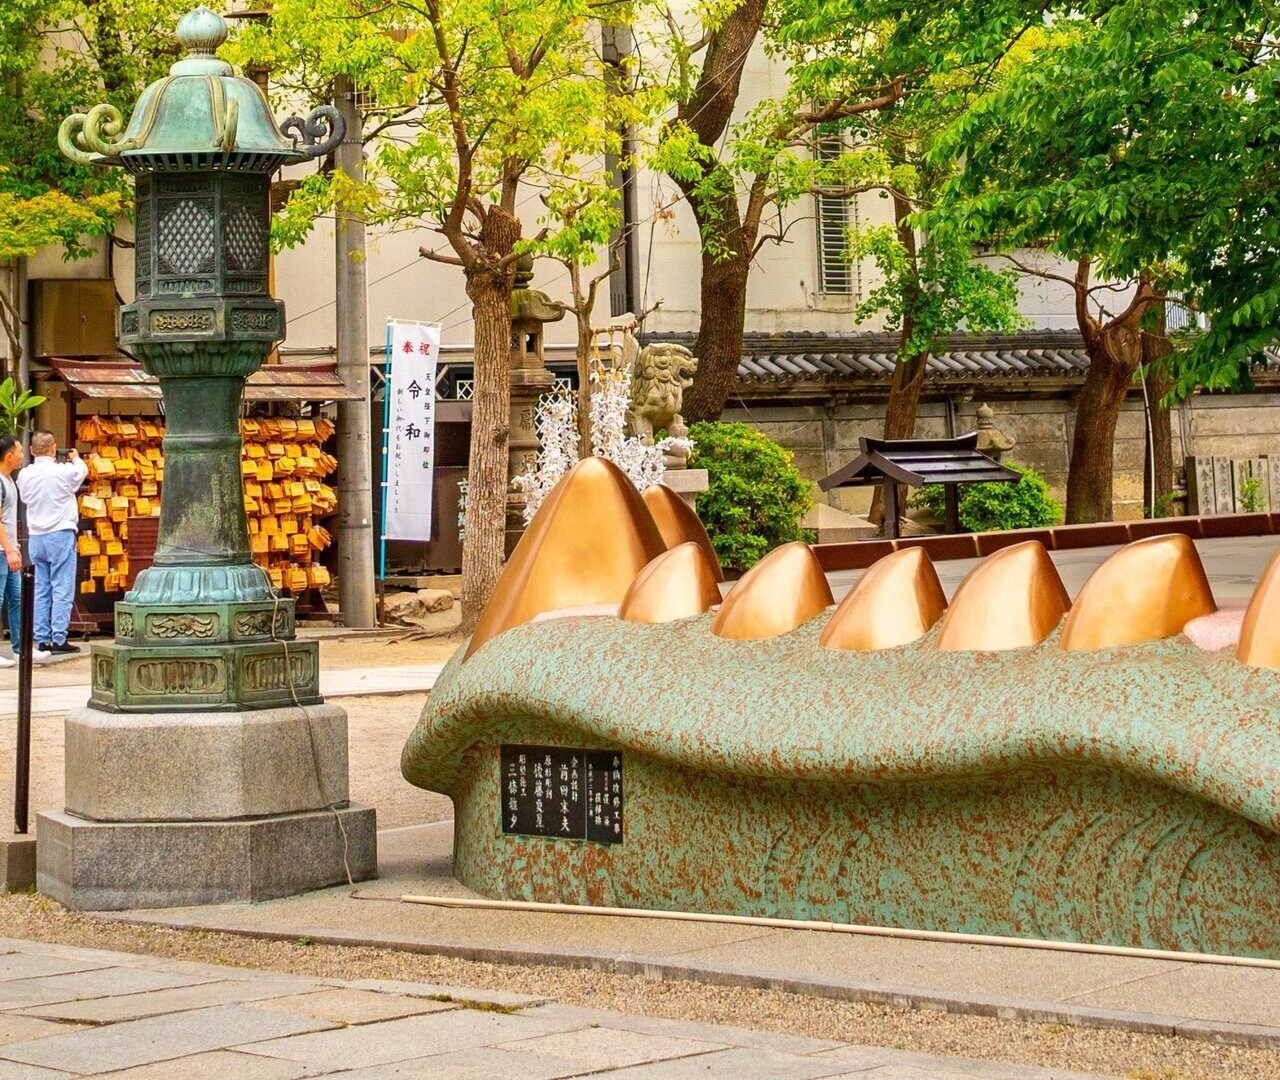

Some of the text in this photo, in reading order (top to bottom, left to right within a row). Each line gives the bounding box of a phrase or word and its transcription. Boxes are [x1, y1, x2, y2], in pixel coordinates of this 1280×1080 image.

[402, 340, 431, 356] 奉祝
[405, 379, 423, 441] 令和
[422, 373, 431, 469] 天皇陛下御即位
